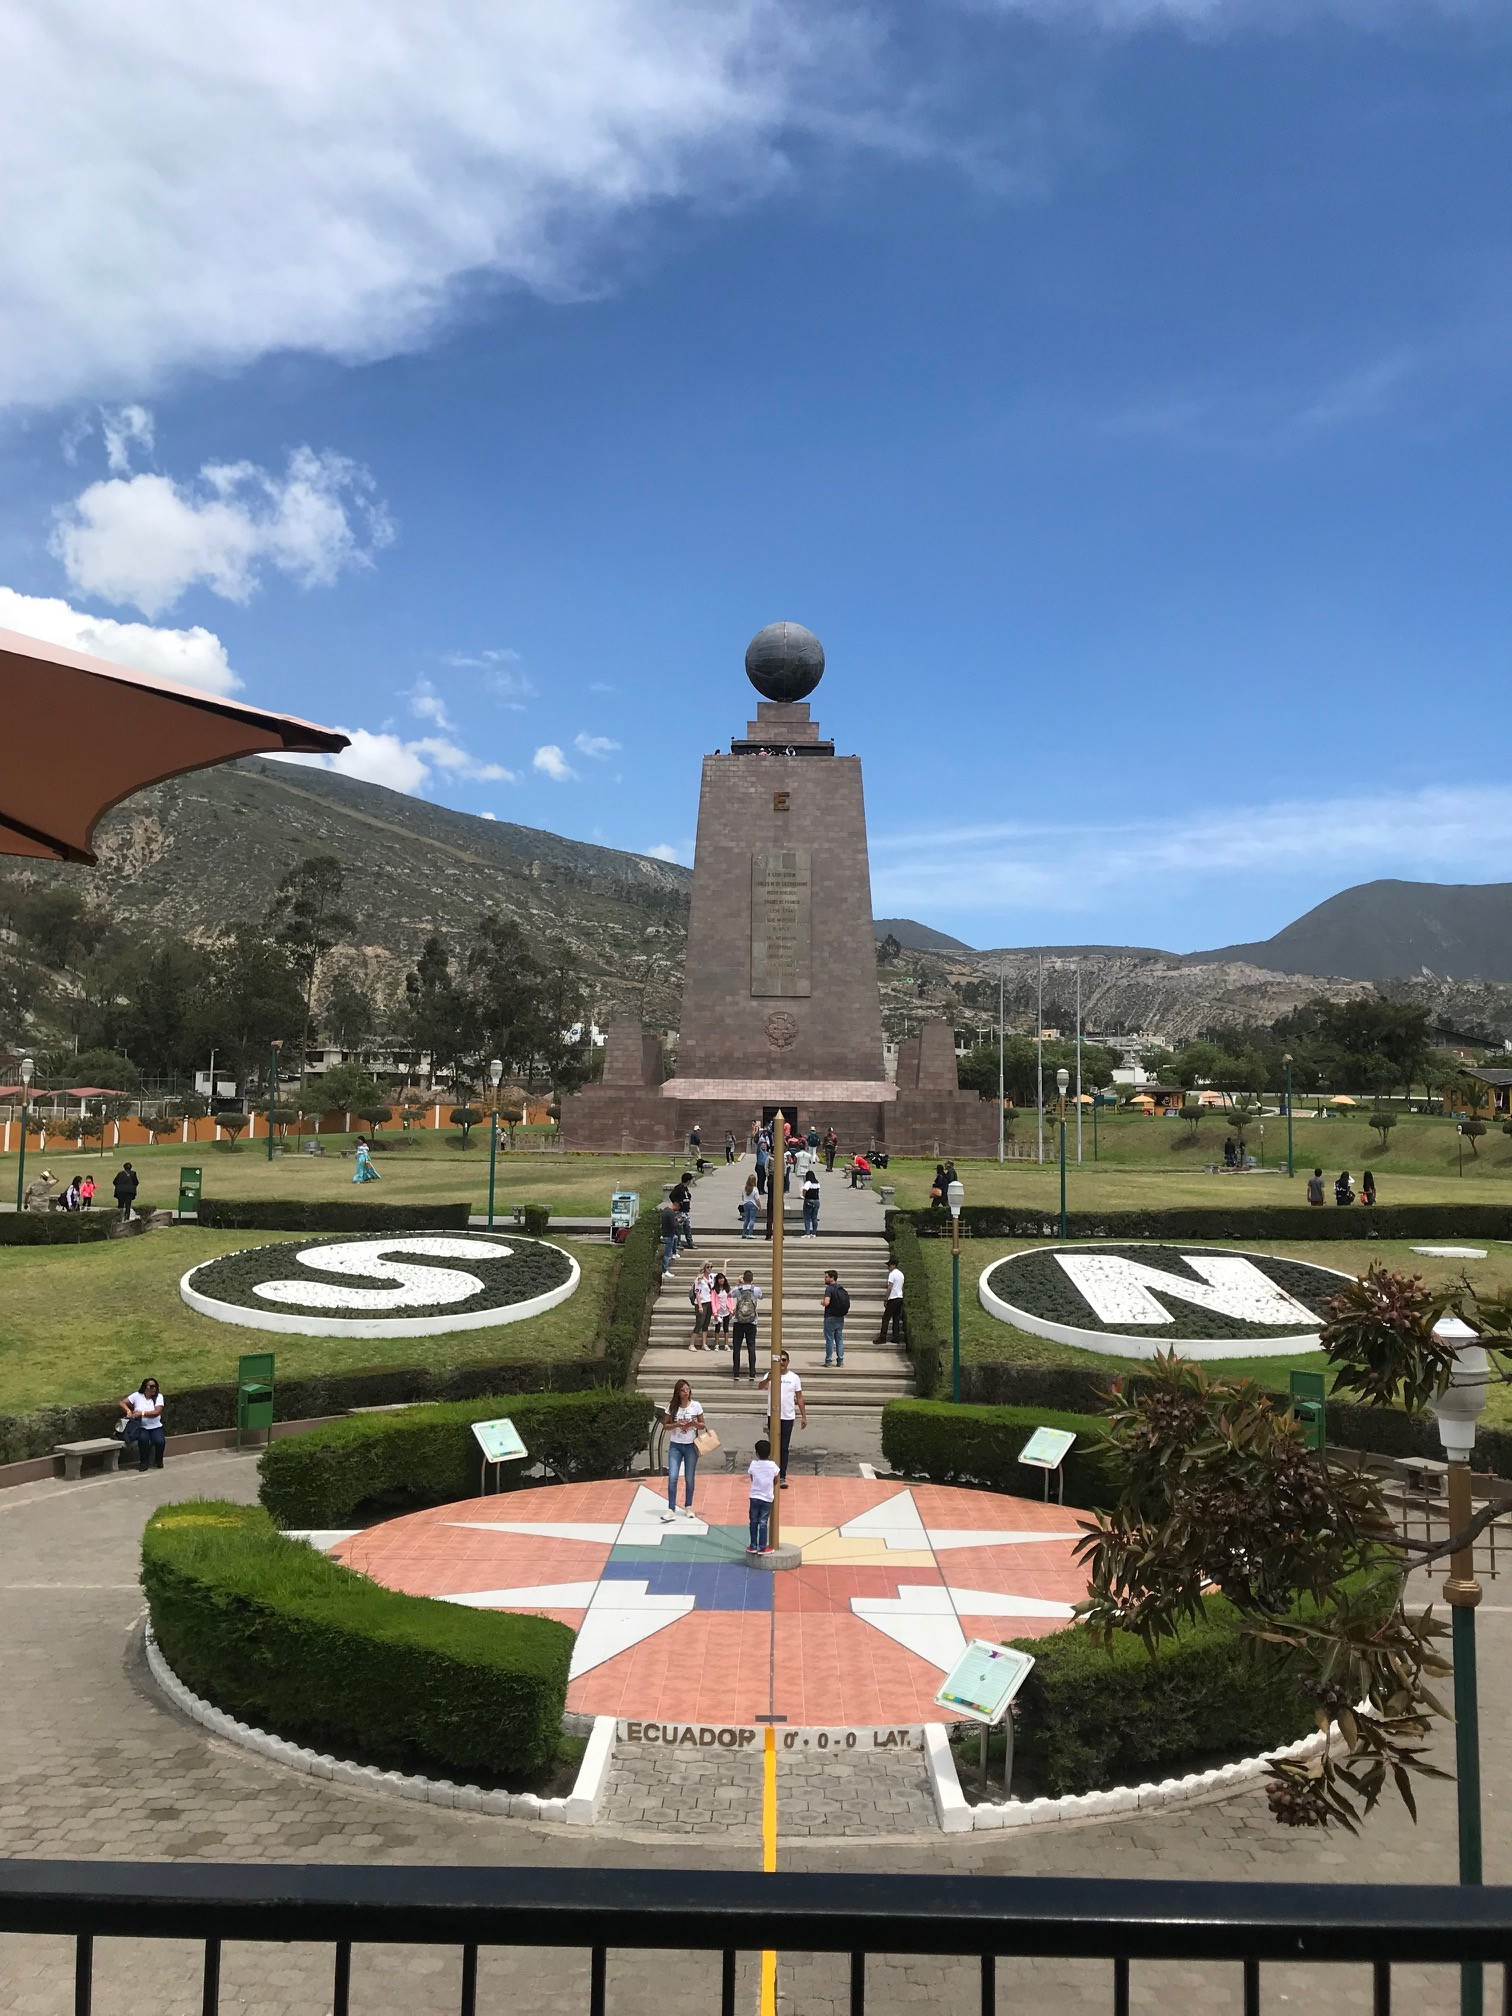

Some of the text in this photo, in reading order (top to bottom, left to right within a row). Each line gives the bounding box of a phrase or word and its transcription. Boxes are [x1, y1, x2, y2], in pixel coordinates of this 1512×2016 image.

[773, 791, 790, 810] E
[252, 1236, 514, 1310] S
[1053, 1254, 1326, 1326] N
[627, 1721, 756, 1748] ECUADOR
